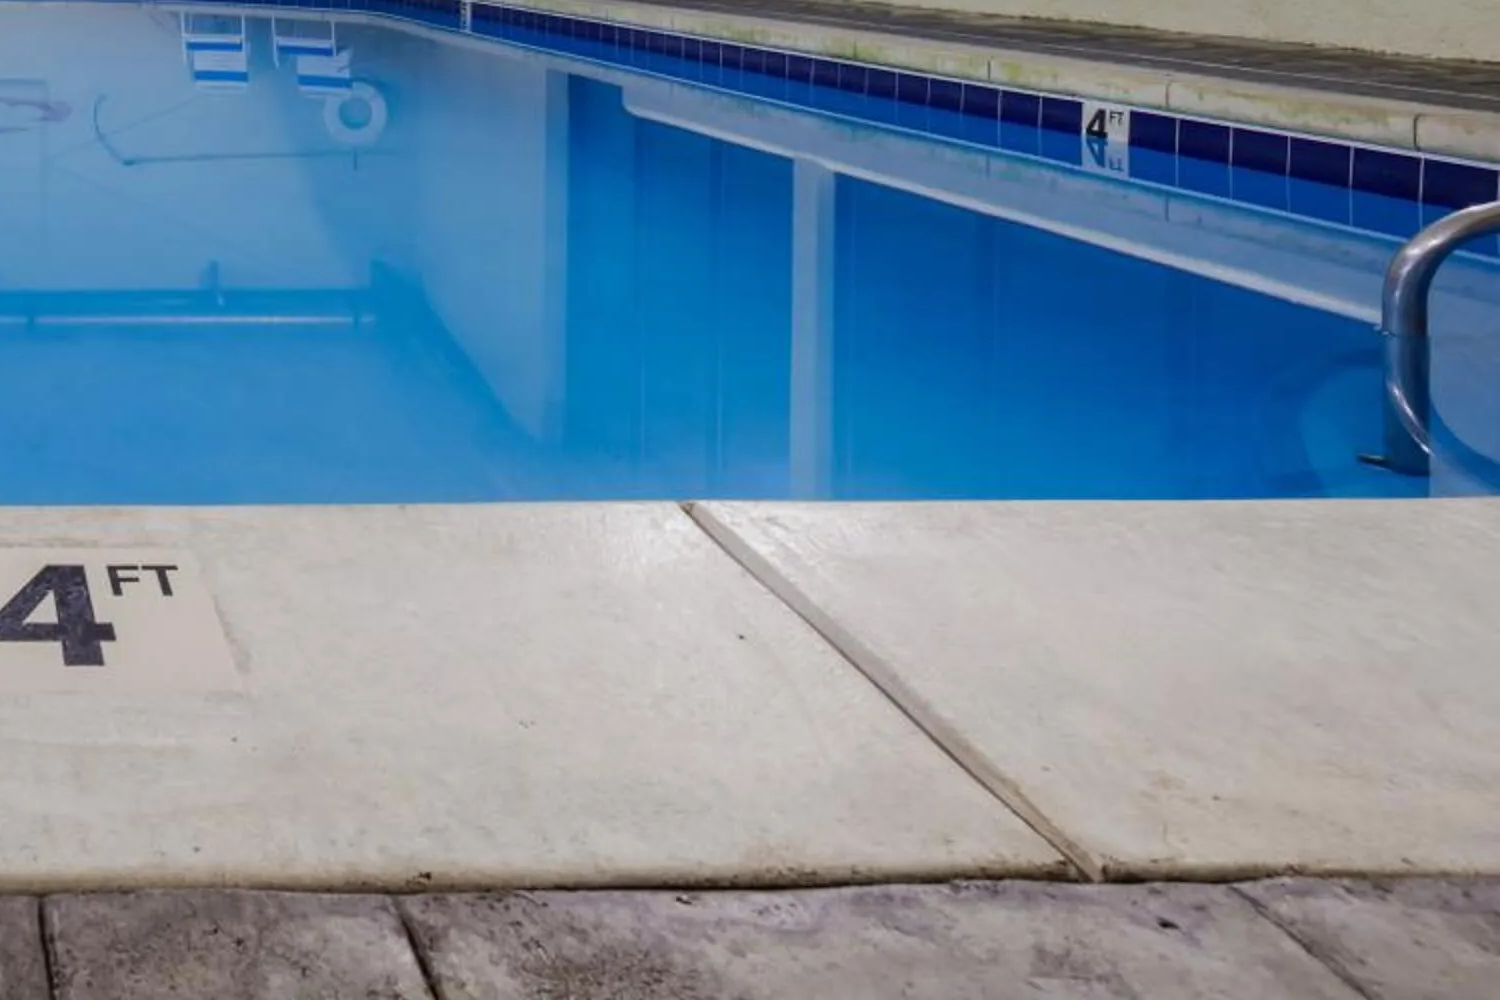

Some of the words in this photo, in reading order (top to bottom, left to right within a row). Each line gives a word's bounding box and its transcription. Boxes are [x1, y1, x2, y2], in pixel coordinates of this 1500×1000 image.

[1085, 108, 1108, 138] 4
[1109, 111, 1125, 126] FT
[106, 564, 179, 597] FT
